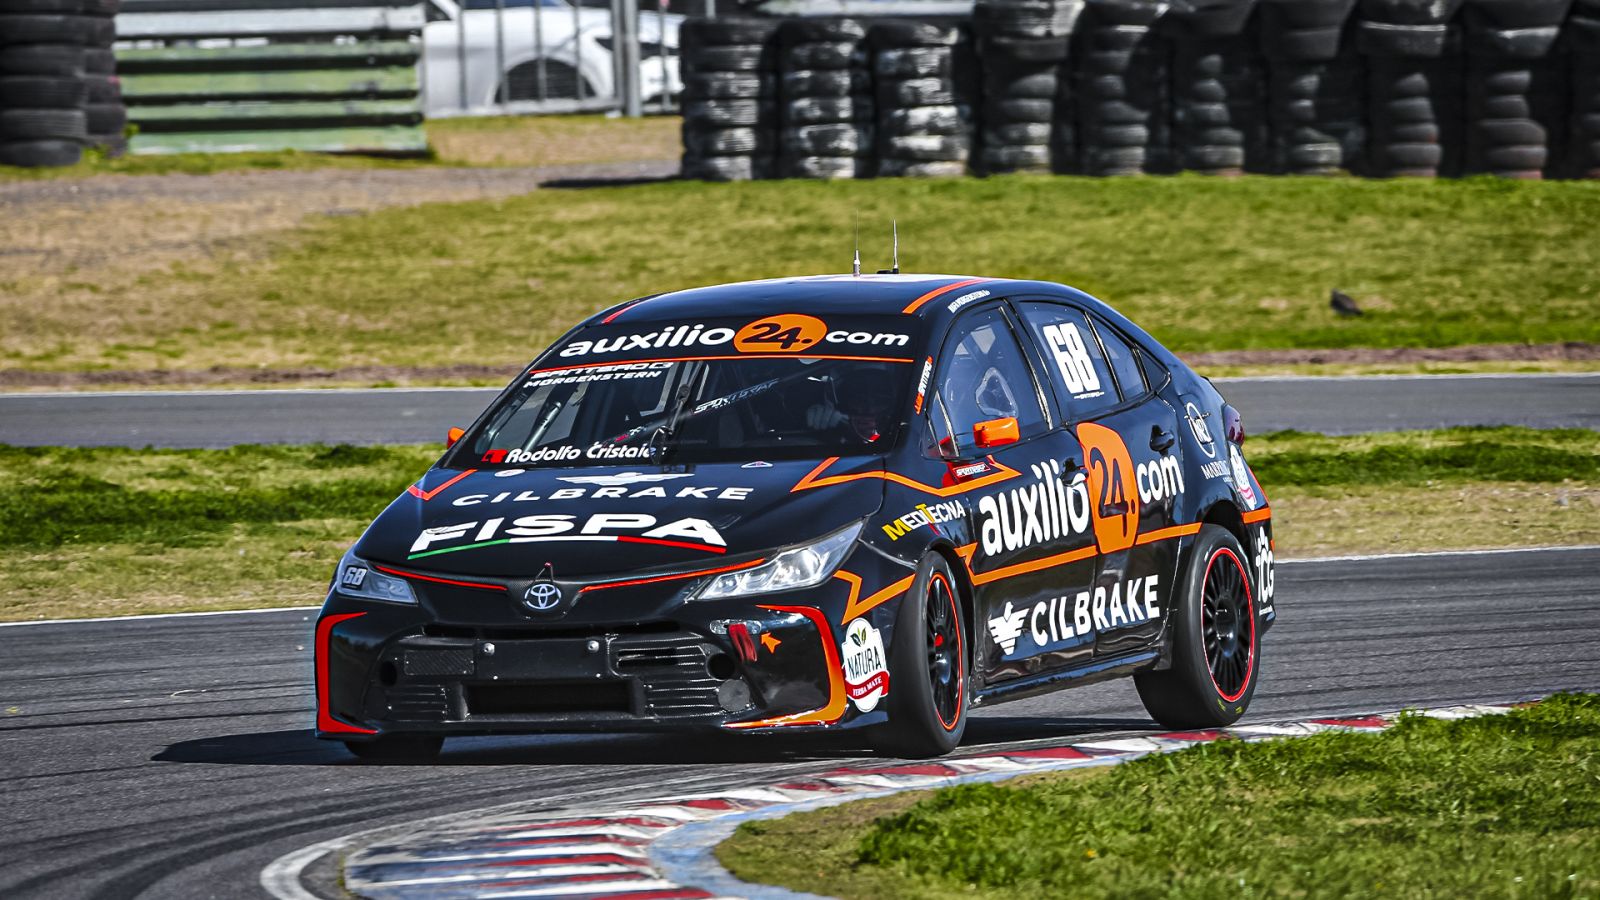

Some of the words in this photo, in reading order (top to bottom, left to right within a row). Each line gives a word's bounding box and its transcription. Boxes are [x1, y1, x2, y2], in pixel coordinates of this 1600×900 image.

[1042, 322, 1101, 394] 68
[523, 370, 662, 389] MORGENSTERN
[504, 445, 582, 463] Rodolfo
[452, 486, 755, 507] CILBRAKE
[409, 513, 729, 554] FISPA
[342, 566, 368, 586] 68
[1031, 574, 1160, 647] CILBRAKE
[847, 645, 882, 681] NATURA
